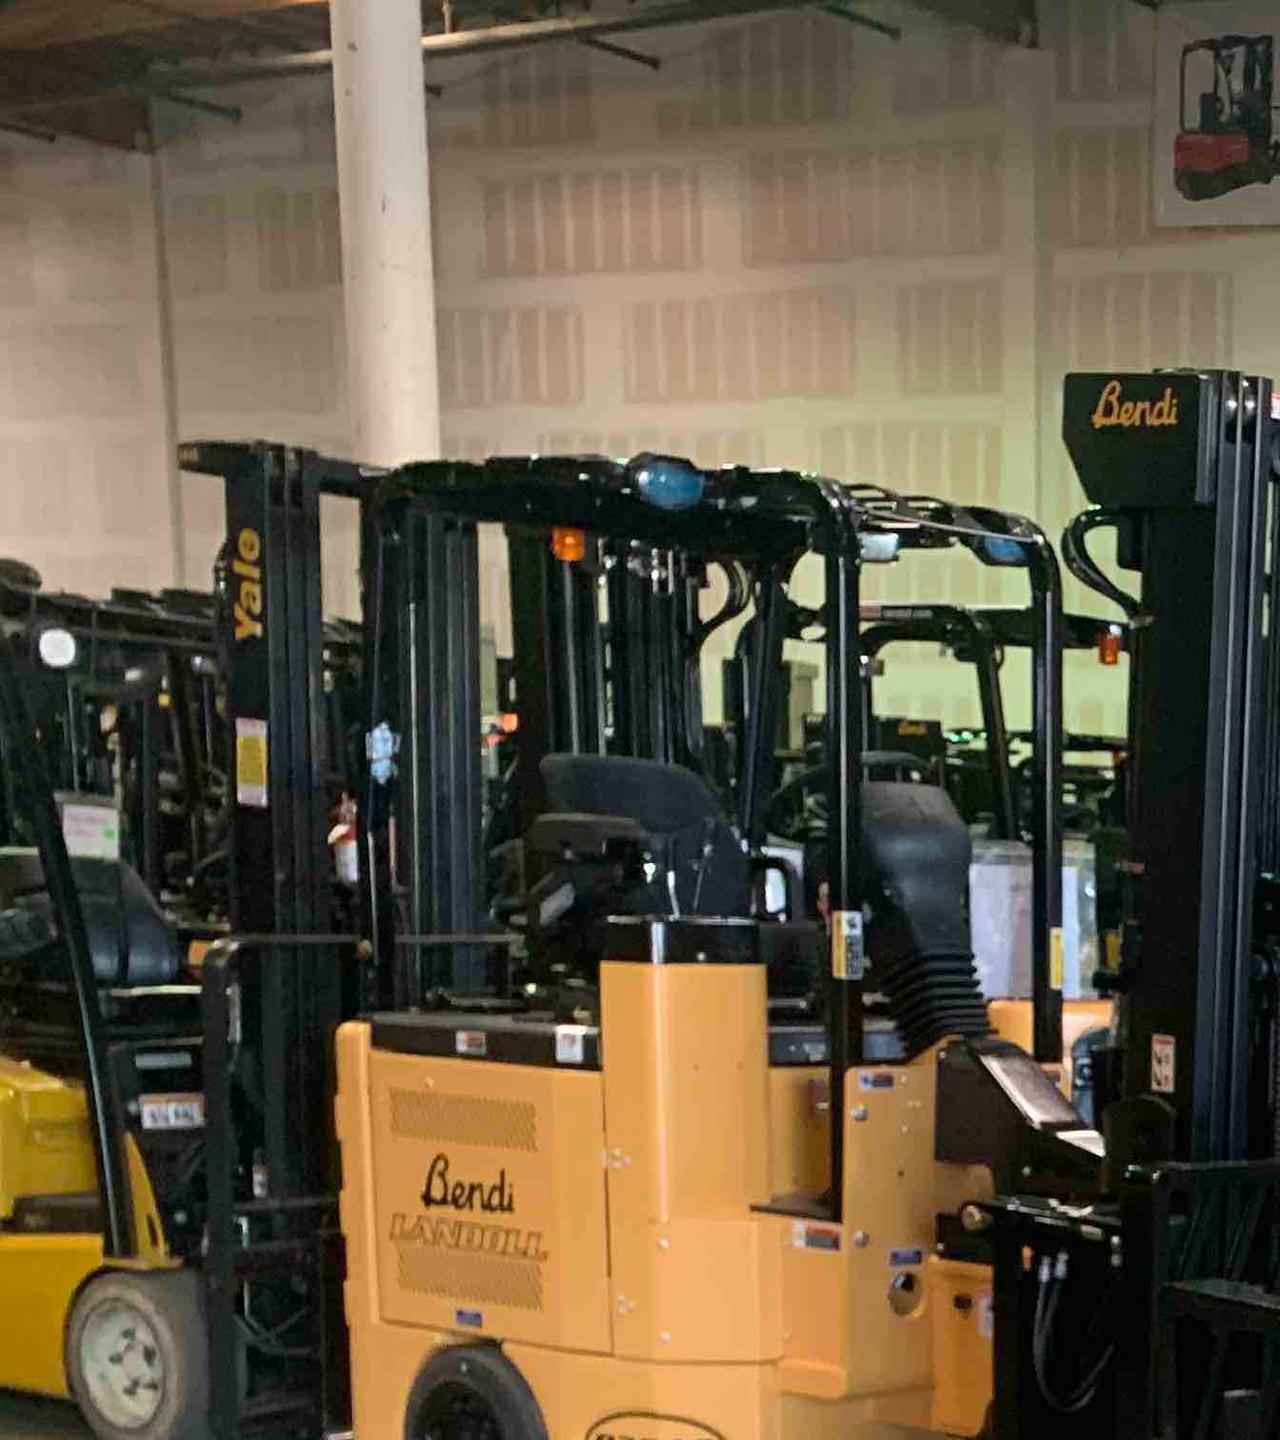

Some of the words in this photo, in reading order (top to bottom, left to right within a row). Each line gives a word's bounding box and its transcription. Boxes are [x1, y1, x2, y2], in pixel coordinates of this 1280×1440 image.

[1091, 379, 1178, 429] Bendi
[233, 527, 262, 640] Yale
[421, 1153, 515, 1212] Bendi
[389, 1212, 548, 1261] LANDOLL
